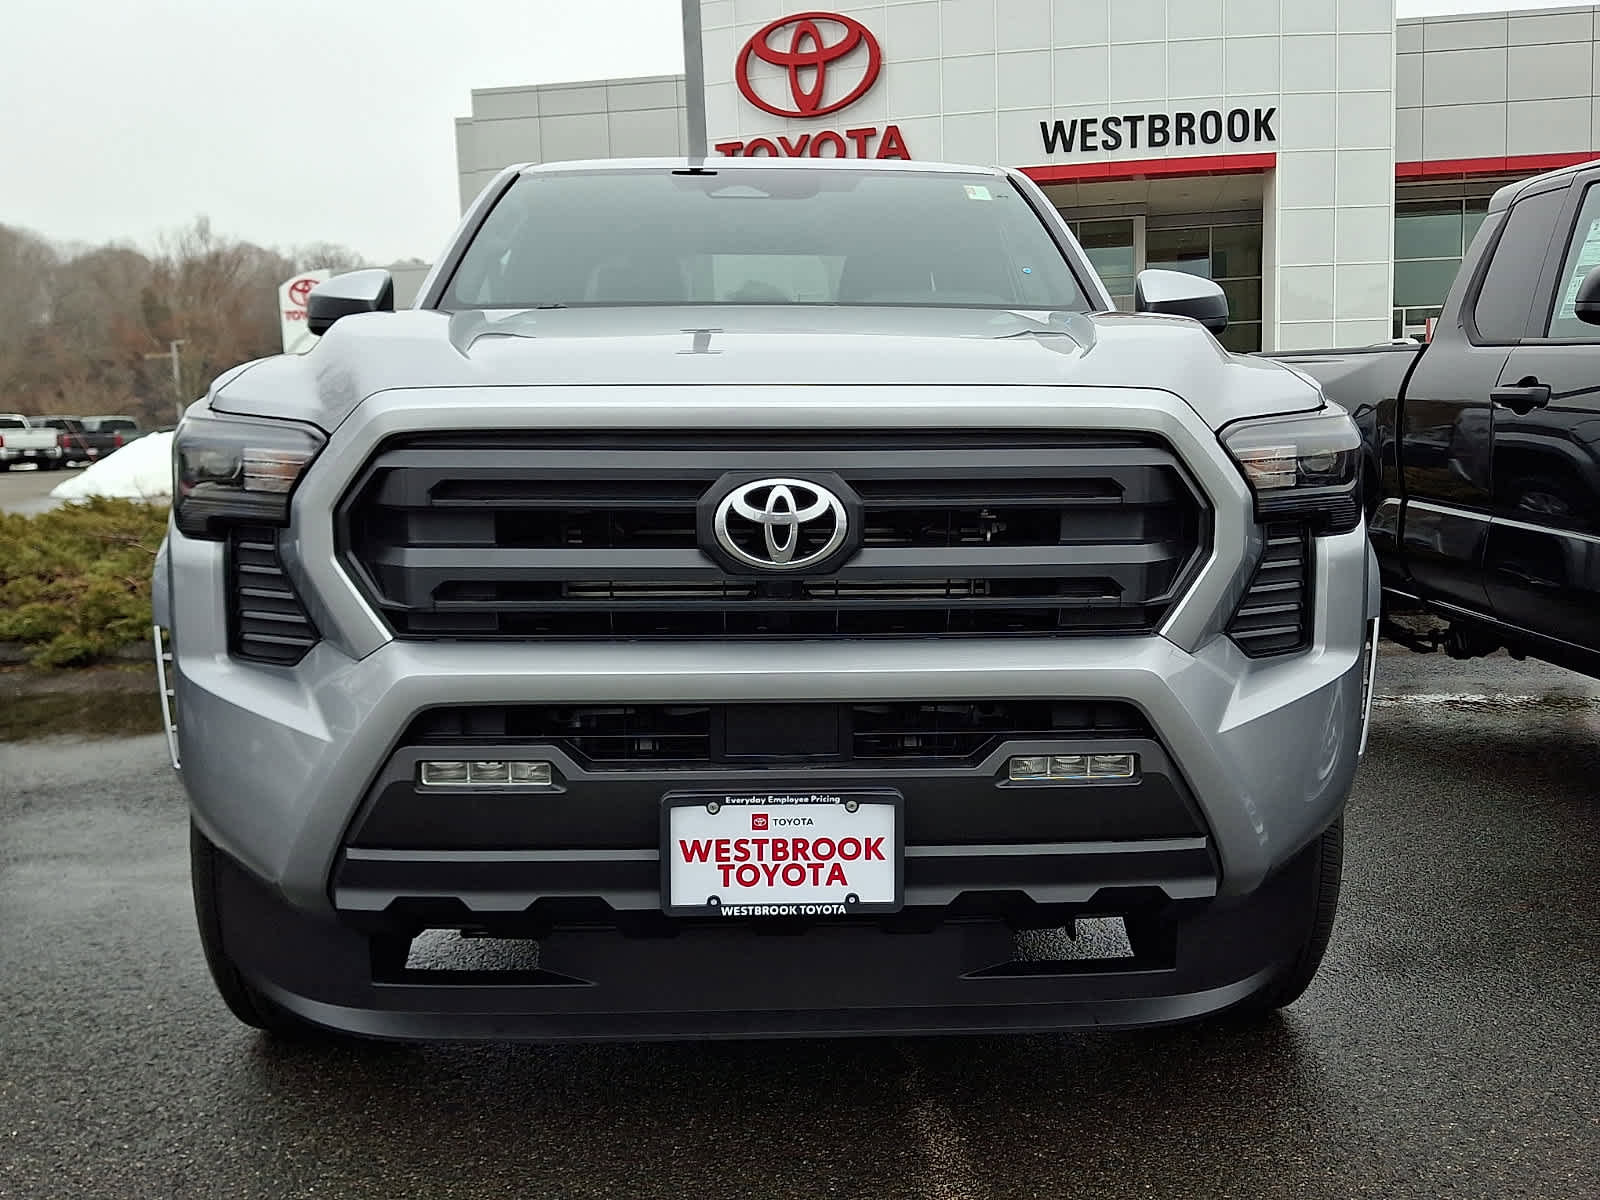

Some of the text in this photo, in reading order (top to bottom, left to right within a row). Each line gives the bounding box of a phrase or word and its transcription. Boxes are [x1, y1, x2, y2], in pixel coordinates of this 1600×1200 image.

[1040, 107, 1277, 154] WESTBROOK
[725, 795, 841, 805] Everyday Employee Pricing
[772, 817, 814, 827] TOYOTA
[679, 837, 886, 863] WESTBROOK
[717, 862, 848, 888] TOYOTA
[721, 904, 847, 916] WESTBROOK TOYOTA
